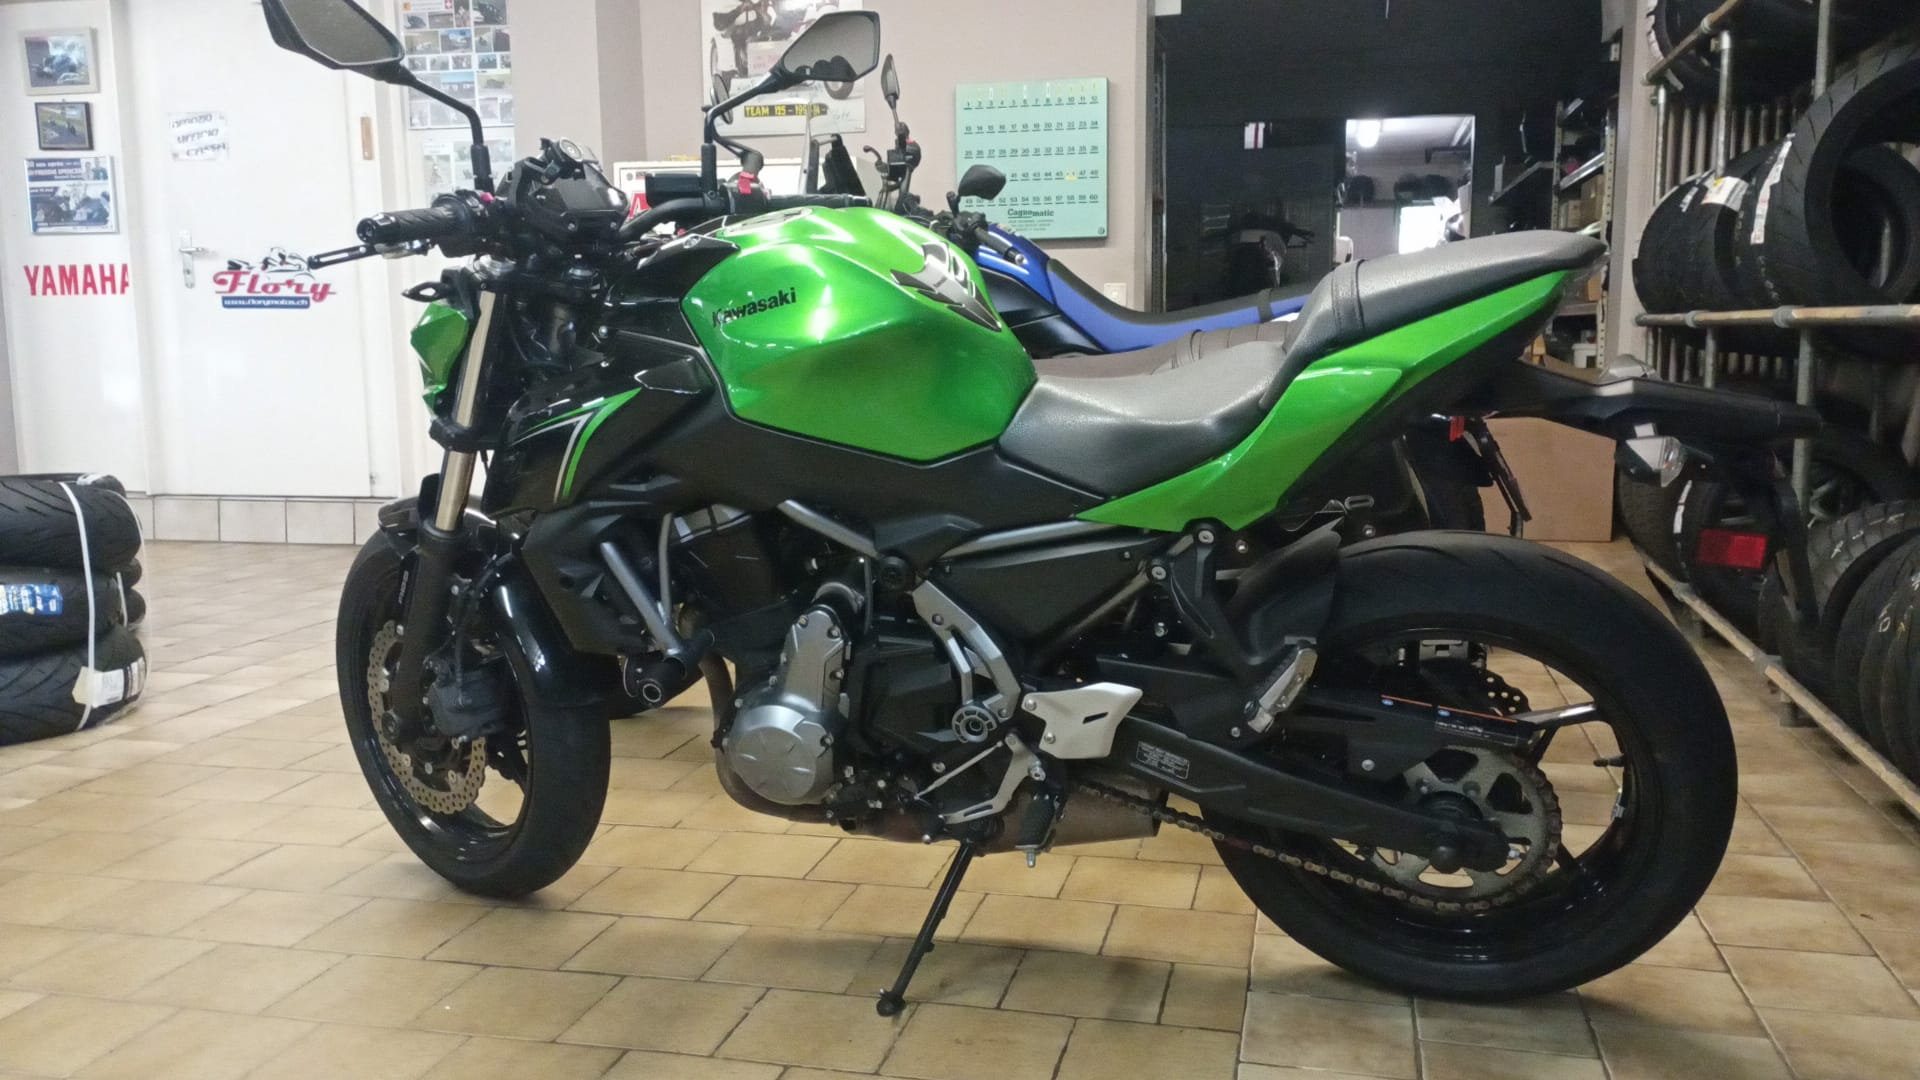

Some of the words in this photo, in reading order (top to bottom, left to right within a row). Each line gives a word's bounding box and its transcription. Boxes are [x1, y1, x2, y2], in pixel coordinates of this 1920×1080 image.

[745, 104, 769, 117] TEAM
[213, 270, 337, 302] Flory
[712, 287, 796, 327] Kawasaki
